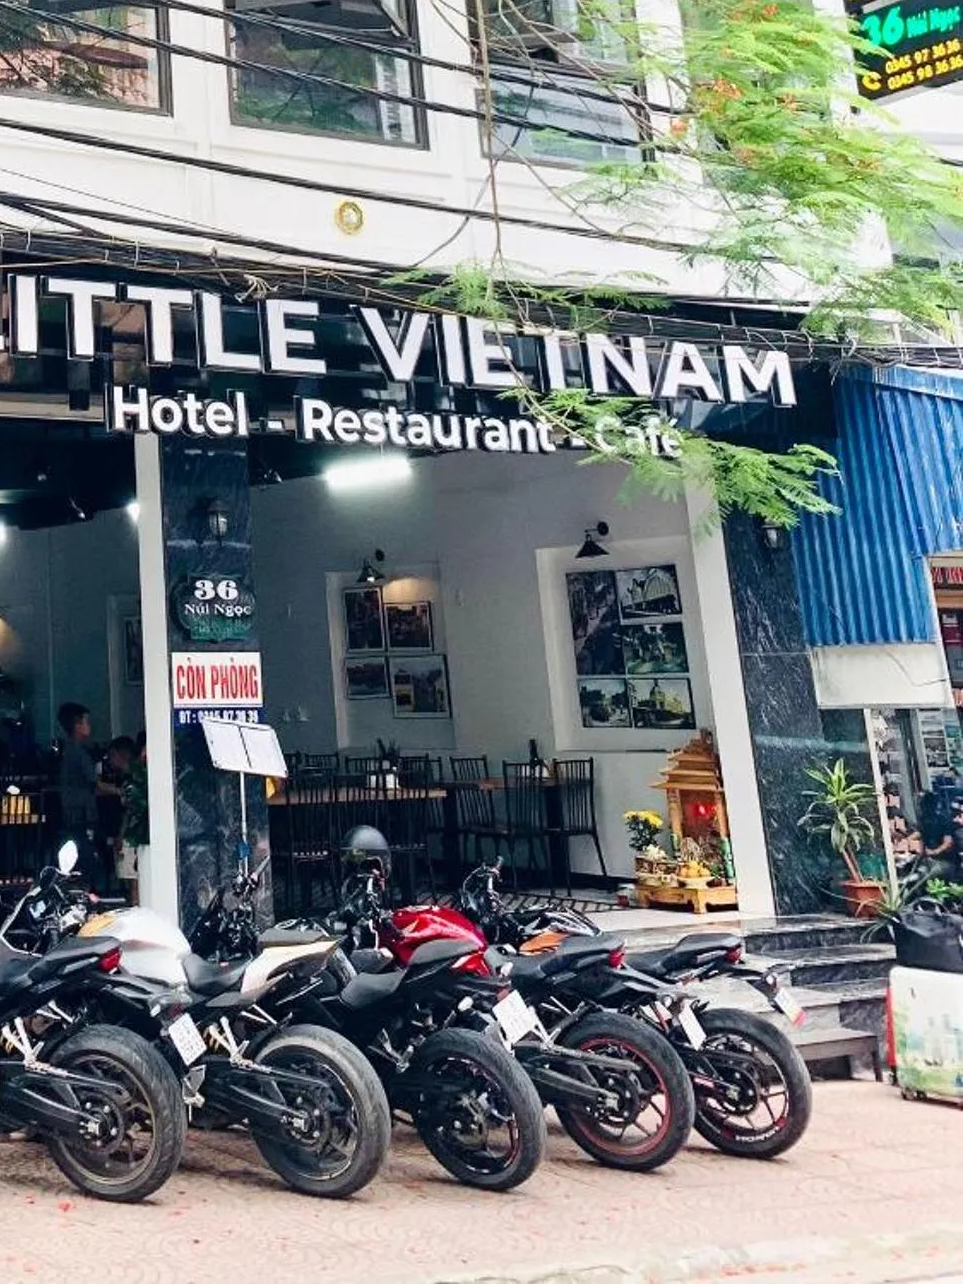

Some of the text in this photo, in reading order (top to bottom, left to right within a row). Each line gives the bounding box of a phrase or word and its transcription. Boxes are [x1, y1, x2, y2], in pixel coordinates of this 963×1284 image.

[359, 306, 797, 405] VIETNAM
[113, 385, 249, 436] Hotel
[302, 398, 556, 452] Restaurant
[194, 579, 239, 600] 36
[176, 657, 258, 699] CÒN PHÒNG
